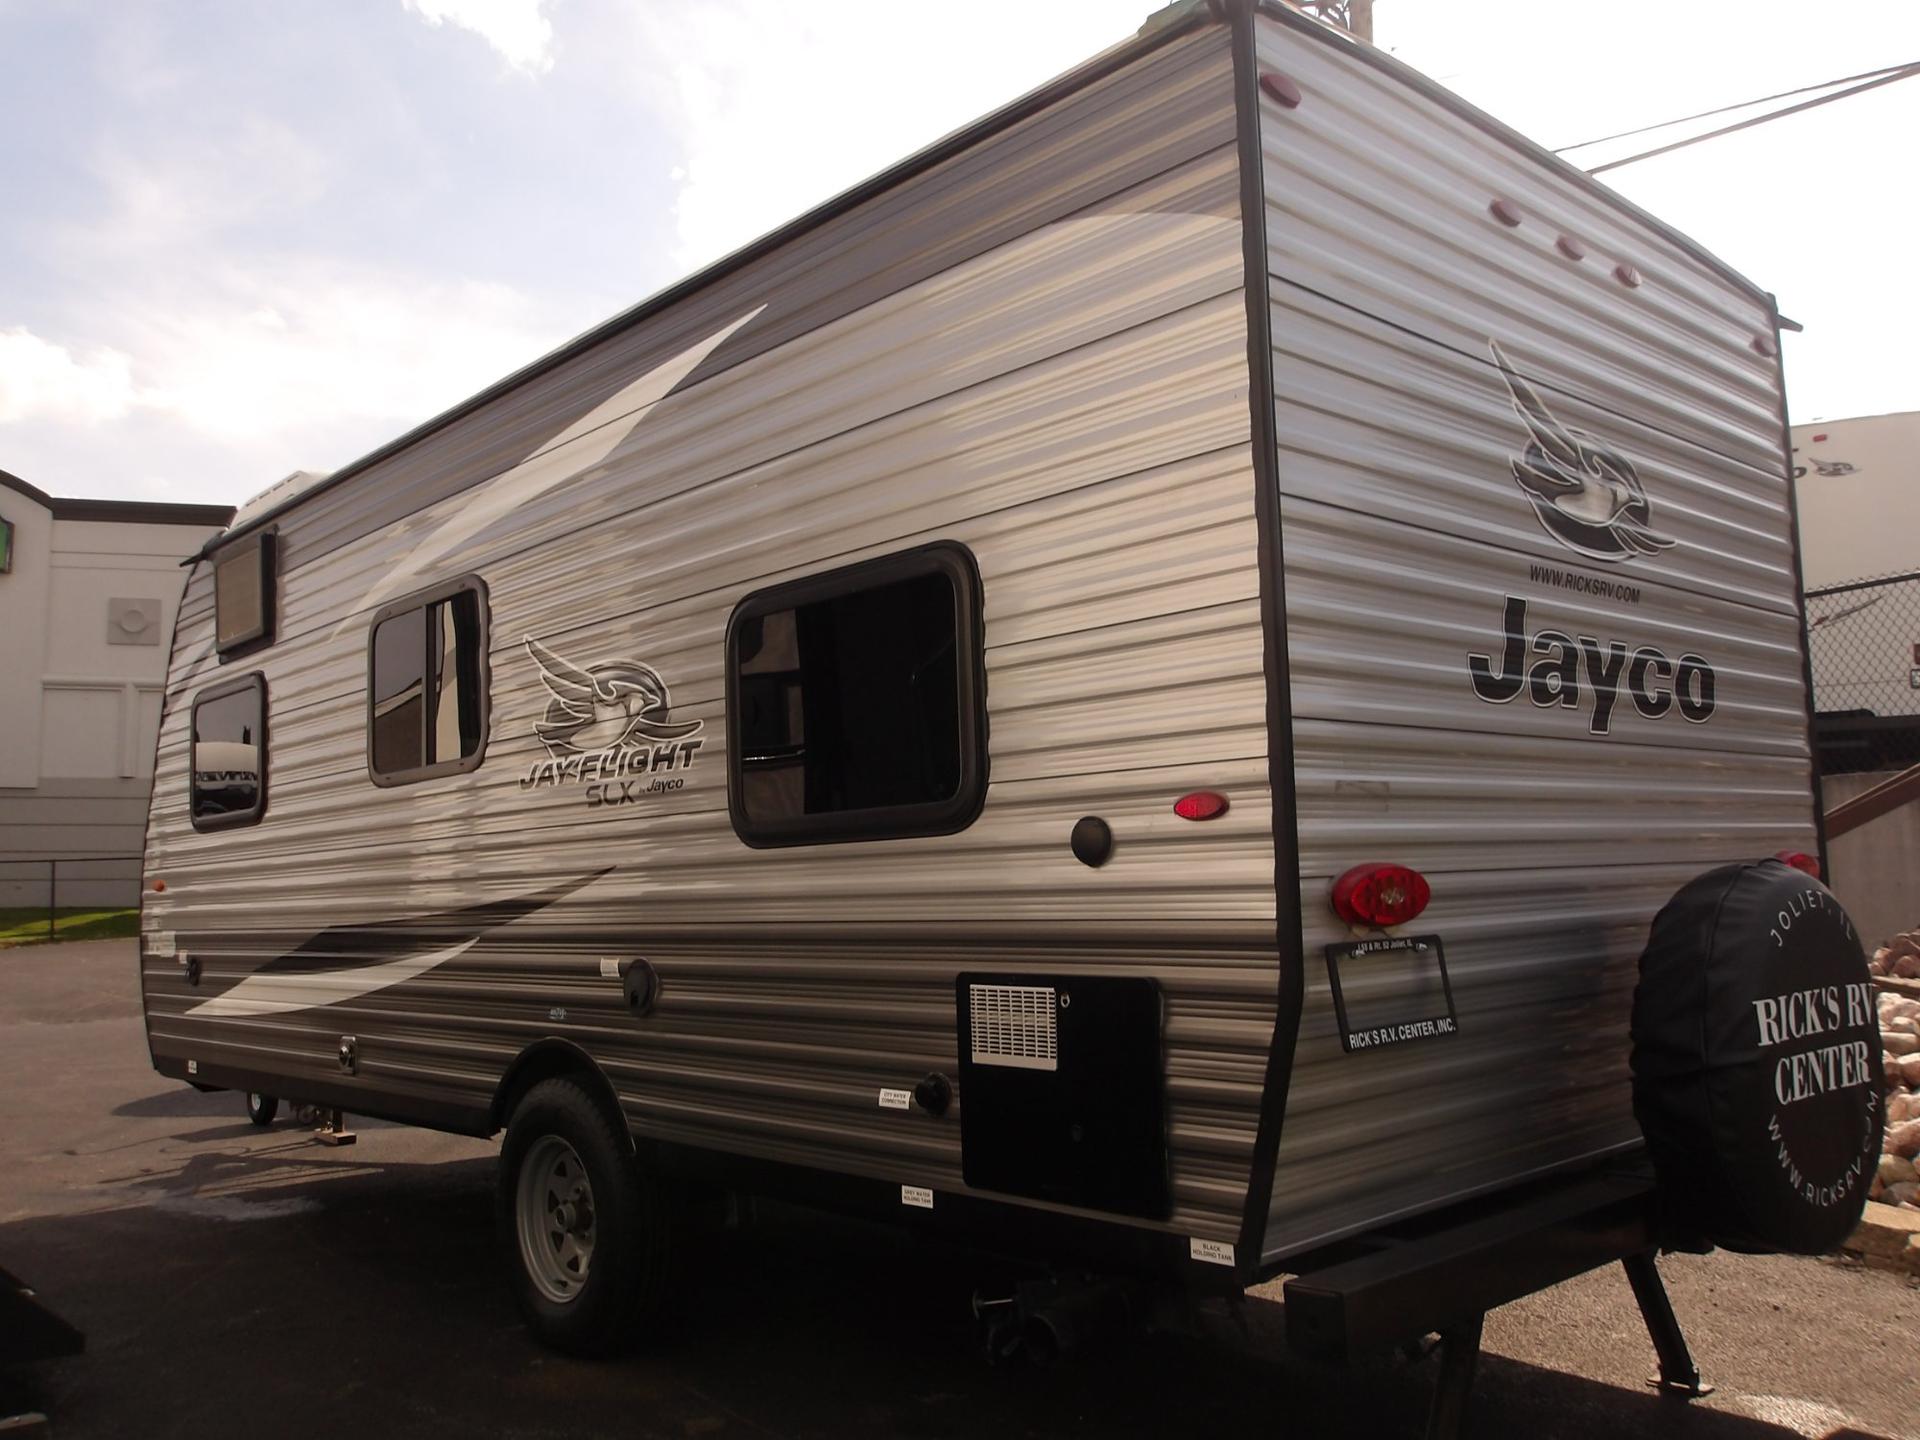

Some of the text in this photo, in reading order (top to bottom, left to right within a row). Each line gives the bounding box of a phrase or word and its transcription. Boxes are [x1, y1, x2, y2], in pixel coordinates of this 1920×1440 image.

[1530, 564, 1641, 604] WWW.RICKSRV.COM
[1467, 593, 1716, 735] Jayco
[585, 777, 684, 808] SLX Jayco
[1752, 983, 1874, 1046] RICK'S RV
[1349, 1030, 1380, 1049] RICK'S
[1380, 1026, 1399, 1043] R.V.
[1775, 1040, 1872, 1105] CENTER
[1767, 1090, 1879, 1208] WWW.RICKSRVCOM
[1192, 1249, 1232, 1261] HOLDING TANK
[1202, 1243, 1221, 1252] BLACK
